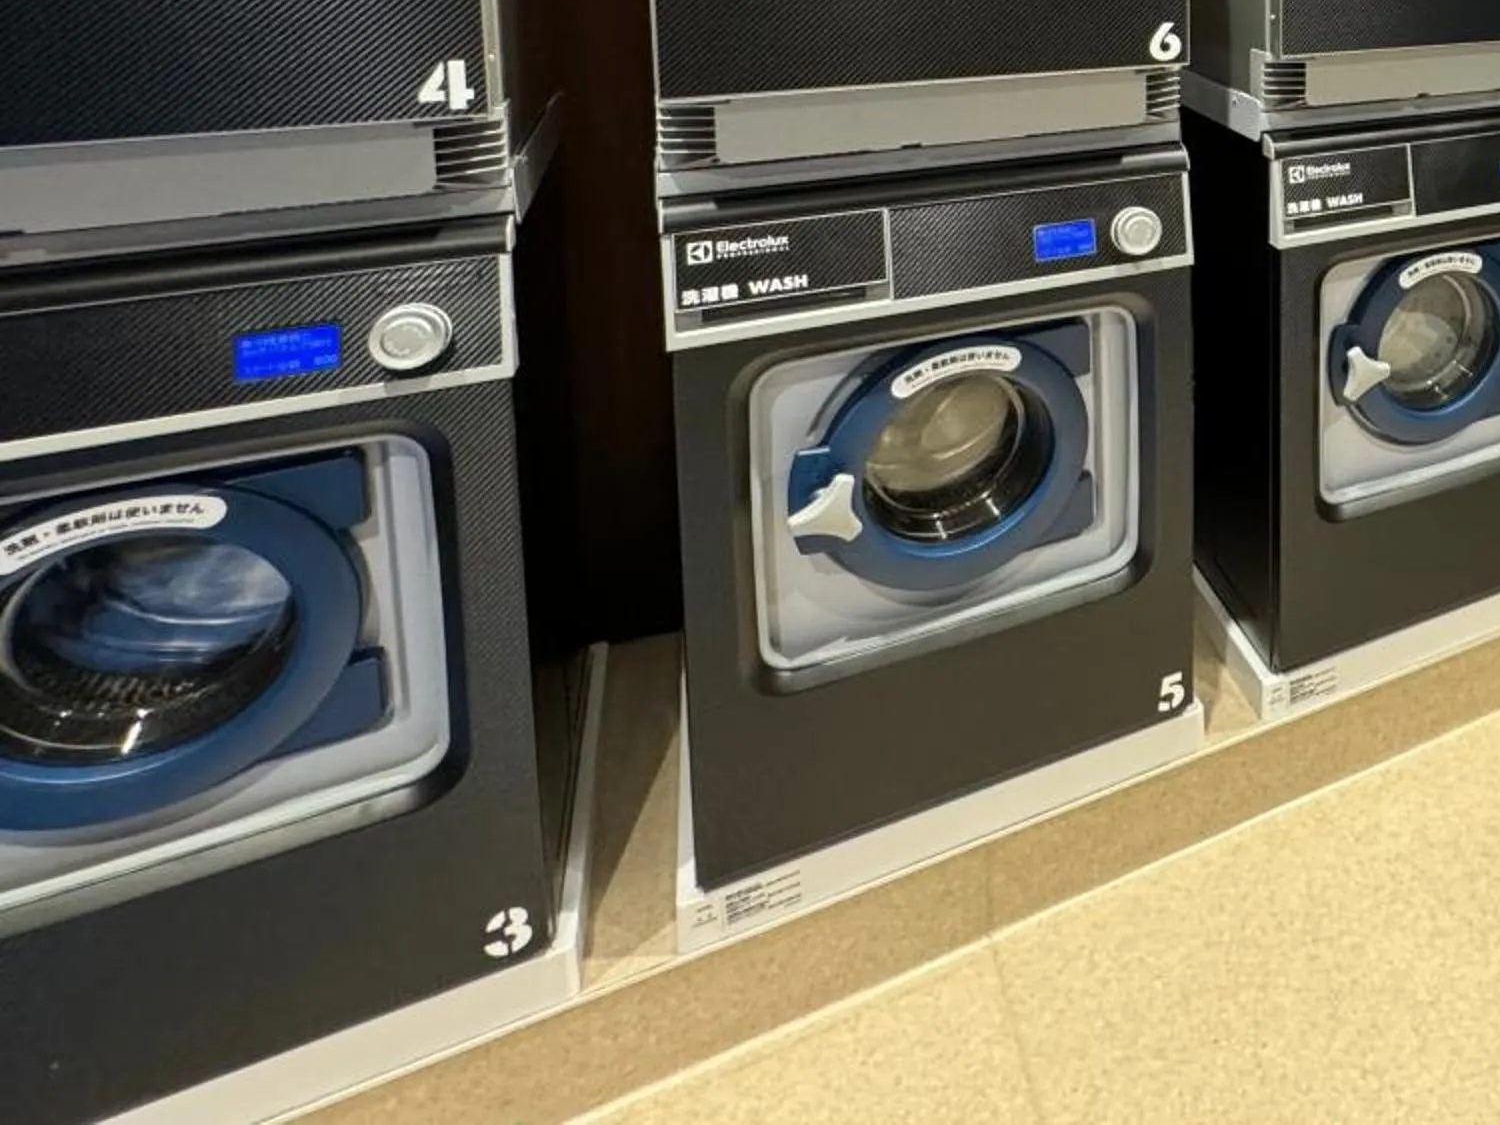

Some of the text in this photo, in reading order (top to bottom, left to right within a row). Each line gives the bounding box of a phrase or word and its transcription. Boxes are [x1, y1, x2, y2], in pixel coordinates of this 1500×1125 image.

[1149, 21, 1182, 62] 6
[418, 59, 475, 110] 4
[1326, 192, 1363, 208] WASH
[716, 234, 790, 253] Electrolux
[748, 274, 809, 295] WASH
[1158, 671, 1185, 712] 5
[484, 906, 533, 959] 3
